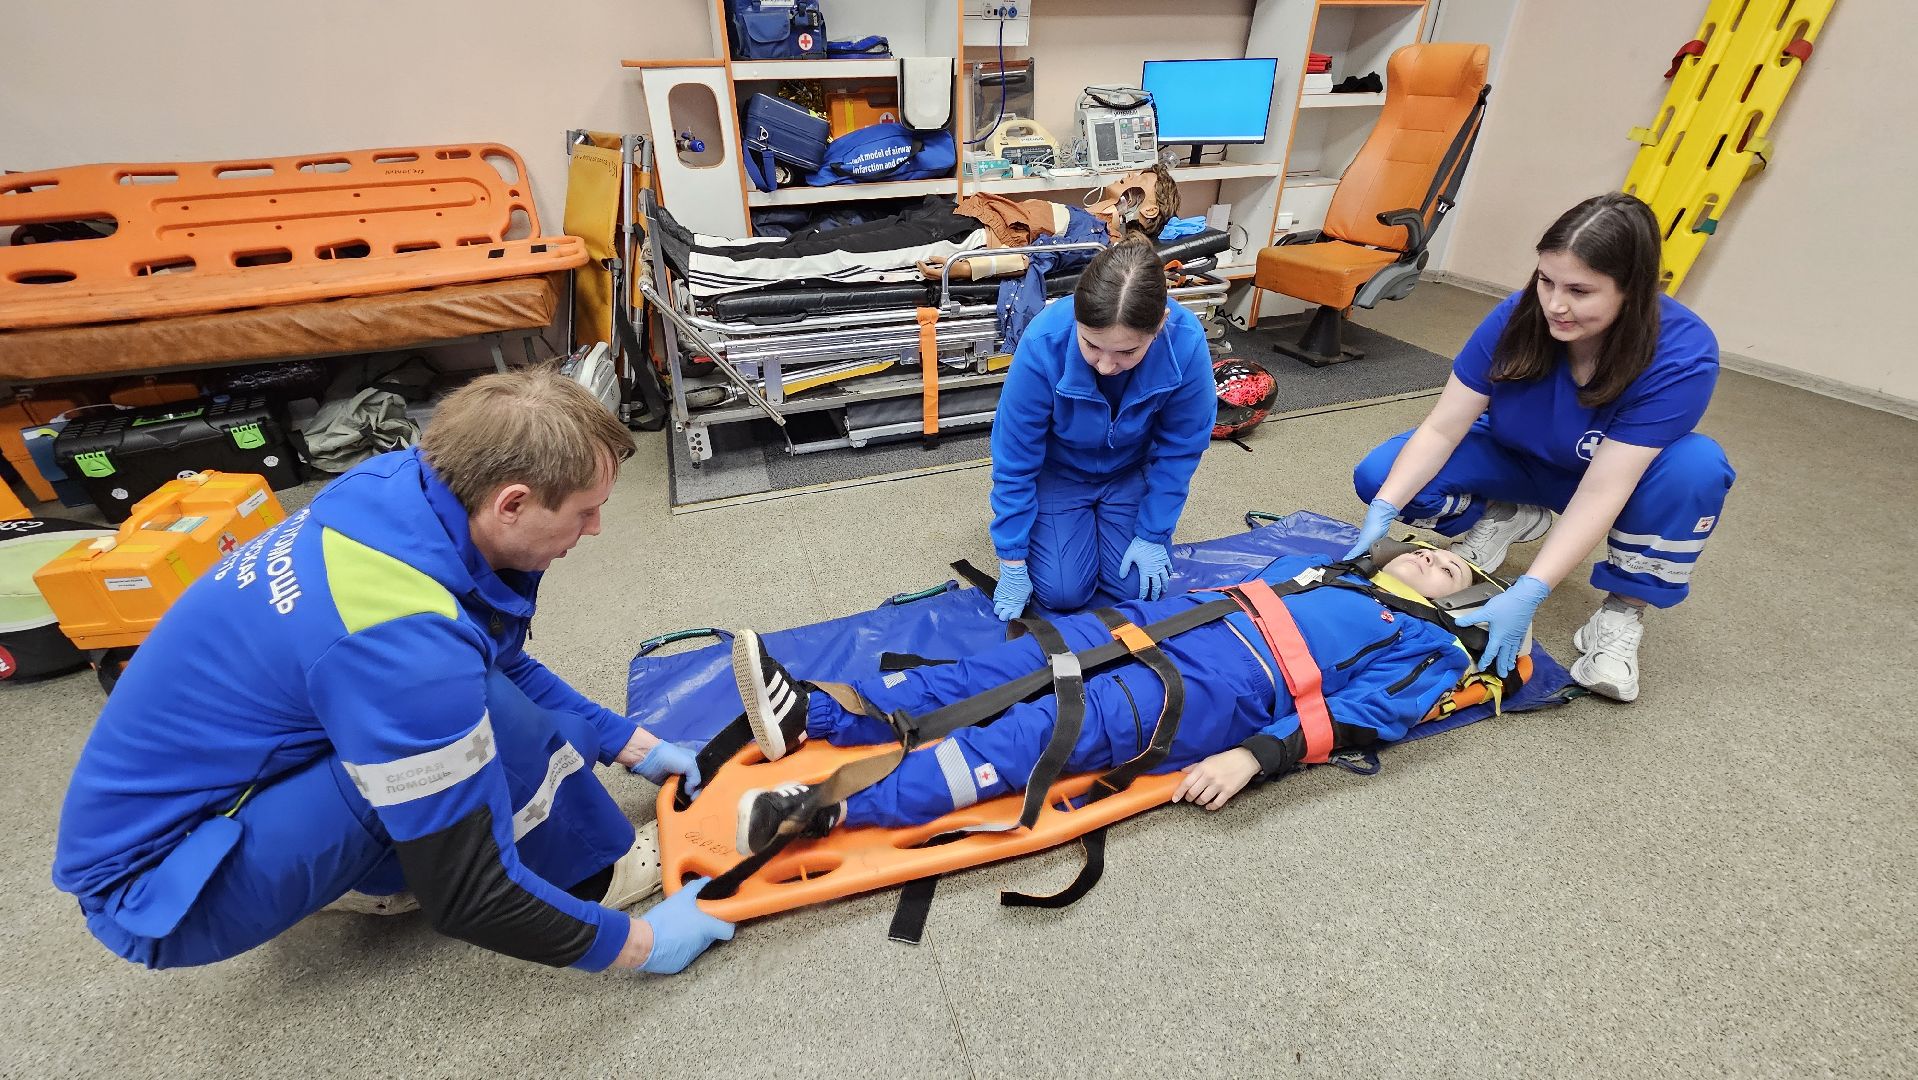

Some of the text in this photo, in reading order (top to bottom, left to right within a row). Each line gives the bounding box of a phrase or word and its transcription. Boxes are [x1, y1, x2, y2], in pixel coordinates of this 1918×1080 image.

[865, 150, 884, 160] model
[884, 147, 892, 156] of
[884, 159, 896, 169] and
[386, 762, 445, 783] СКОРАЯ
[386, 771, 452, 794] ПОМОЩЬ
